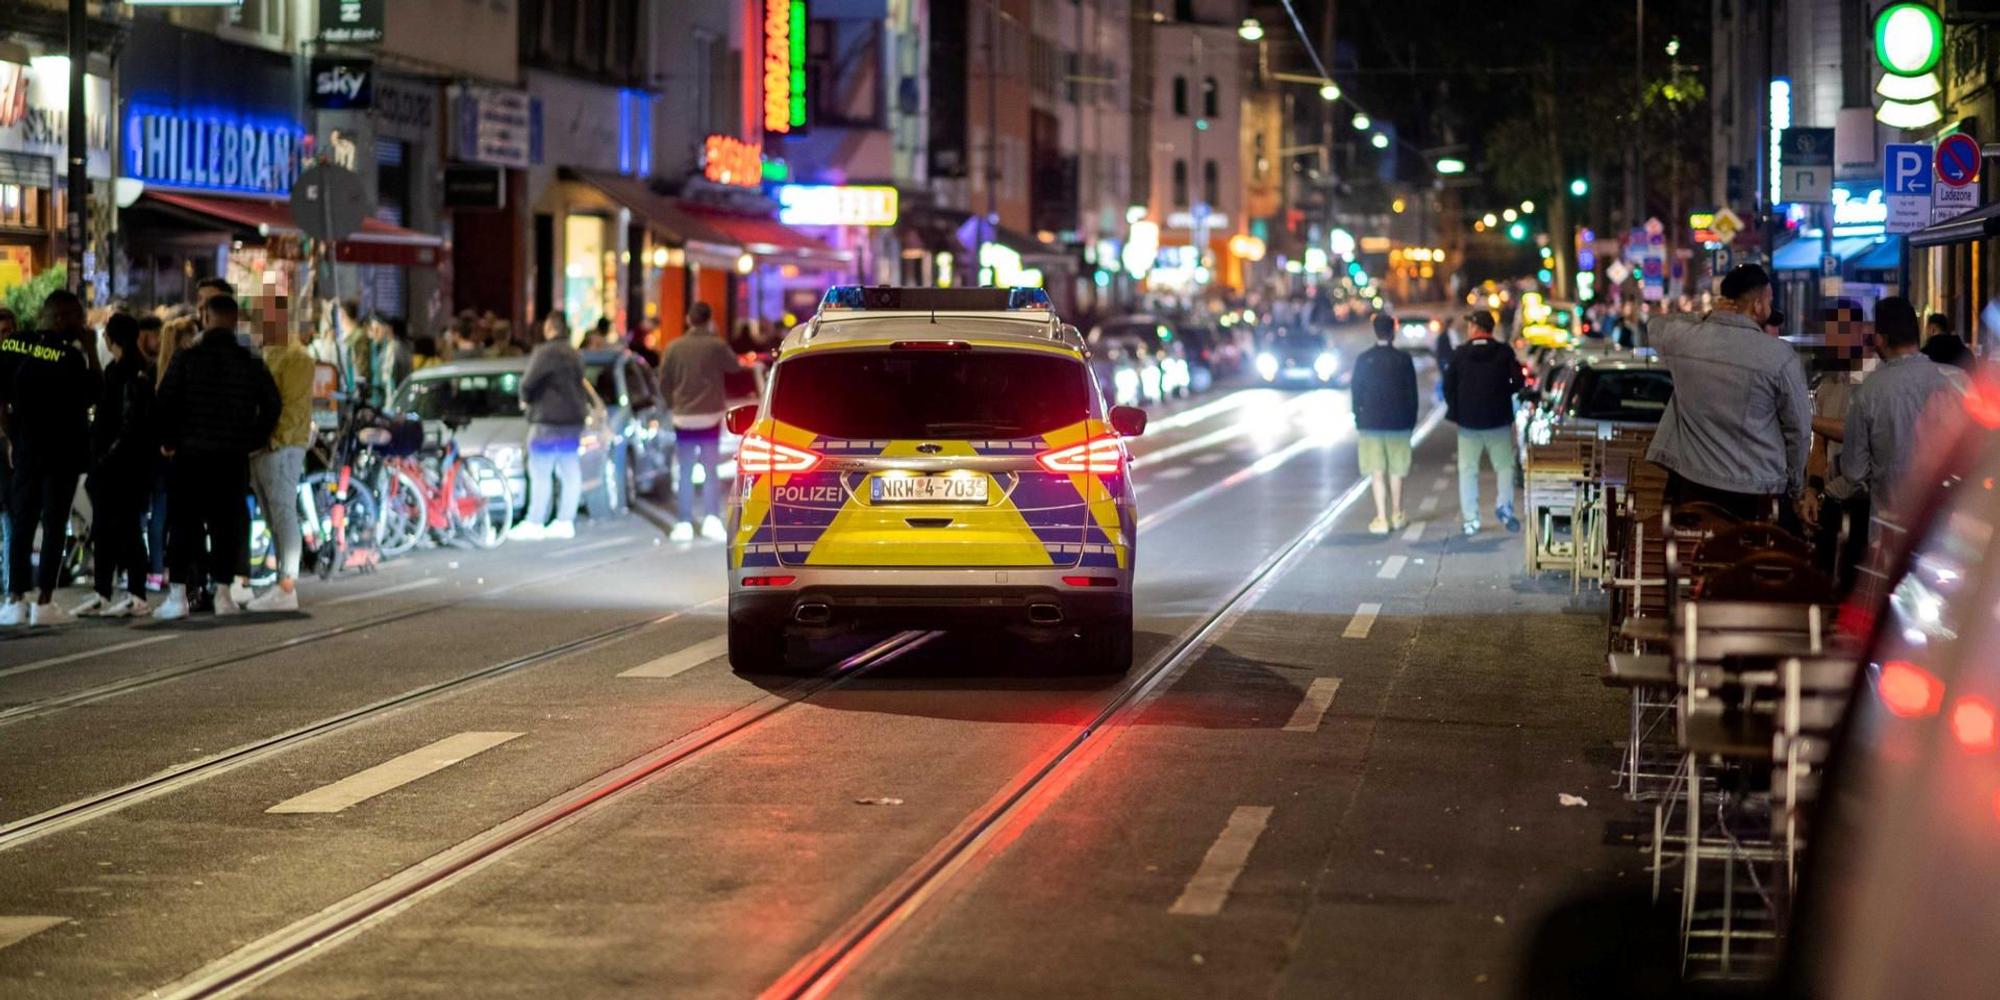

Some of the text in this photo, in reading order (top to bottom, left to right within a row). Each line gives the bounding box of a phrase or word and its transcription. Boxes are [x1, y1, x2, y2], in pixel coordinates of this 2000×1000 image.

[317, 66, 366, 100] sky
[1896, 151, 1922, 192] P
[1940, 188, 1972, 201] Ladezone
[775, 486, 843, 502] POLIZEI
[881, 479, 914, 498] NRW
